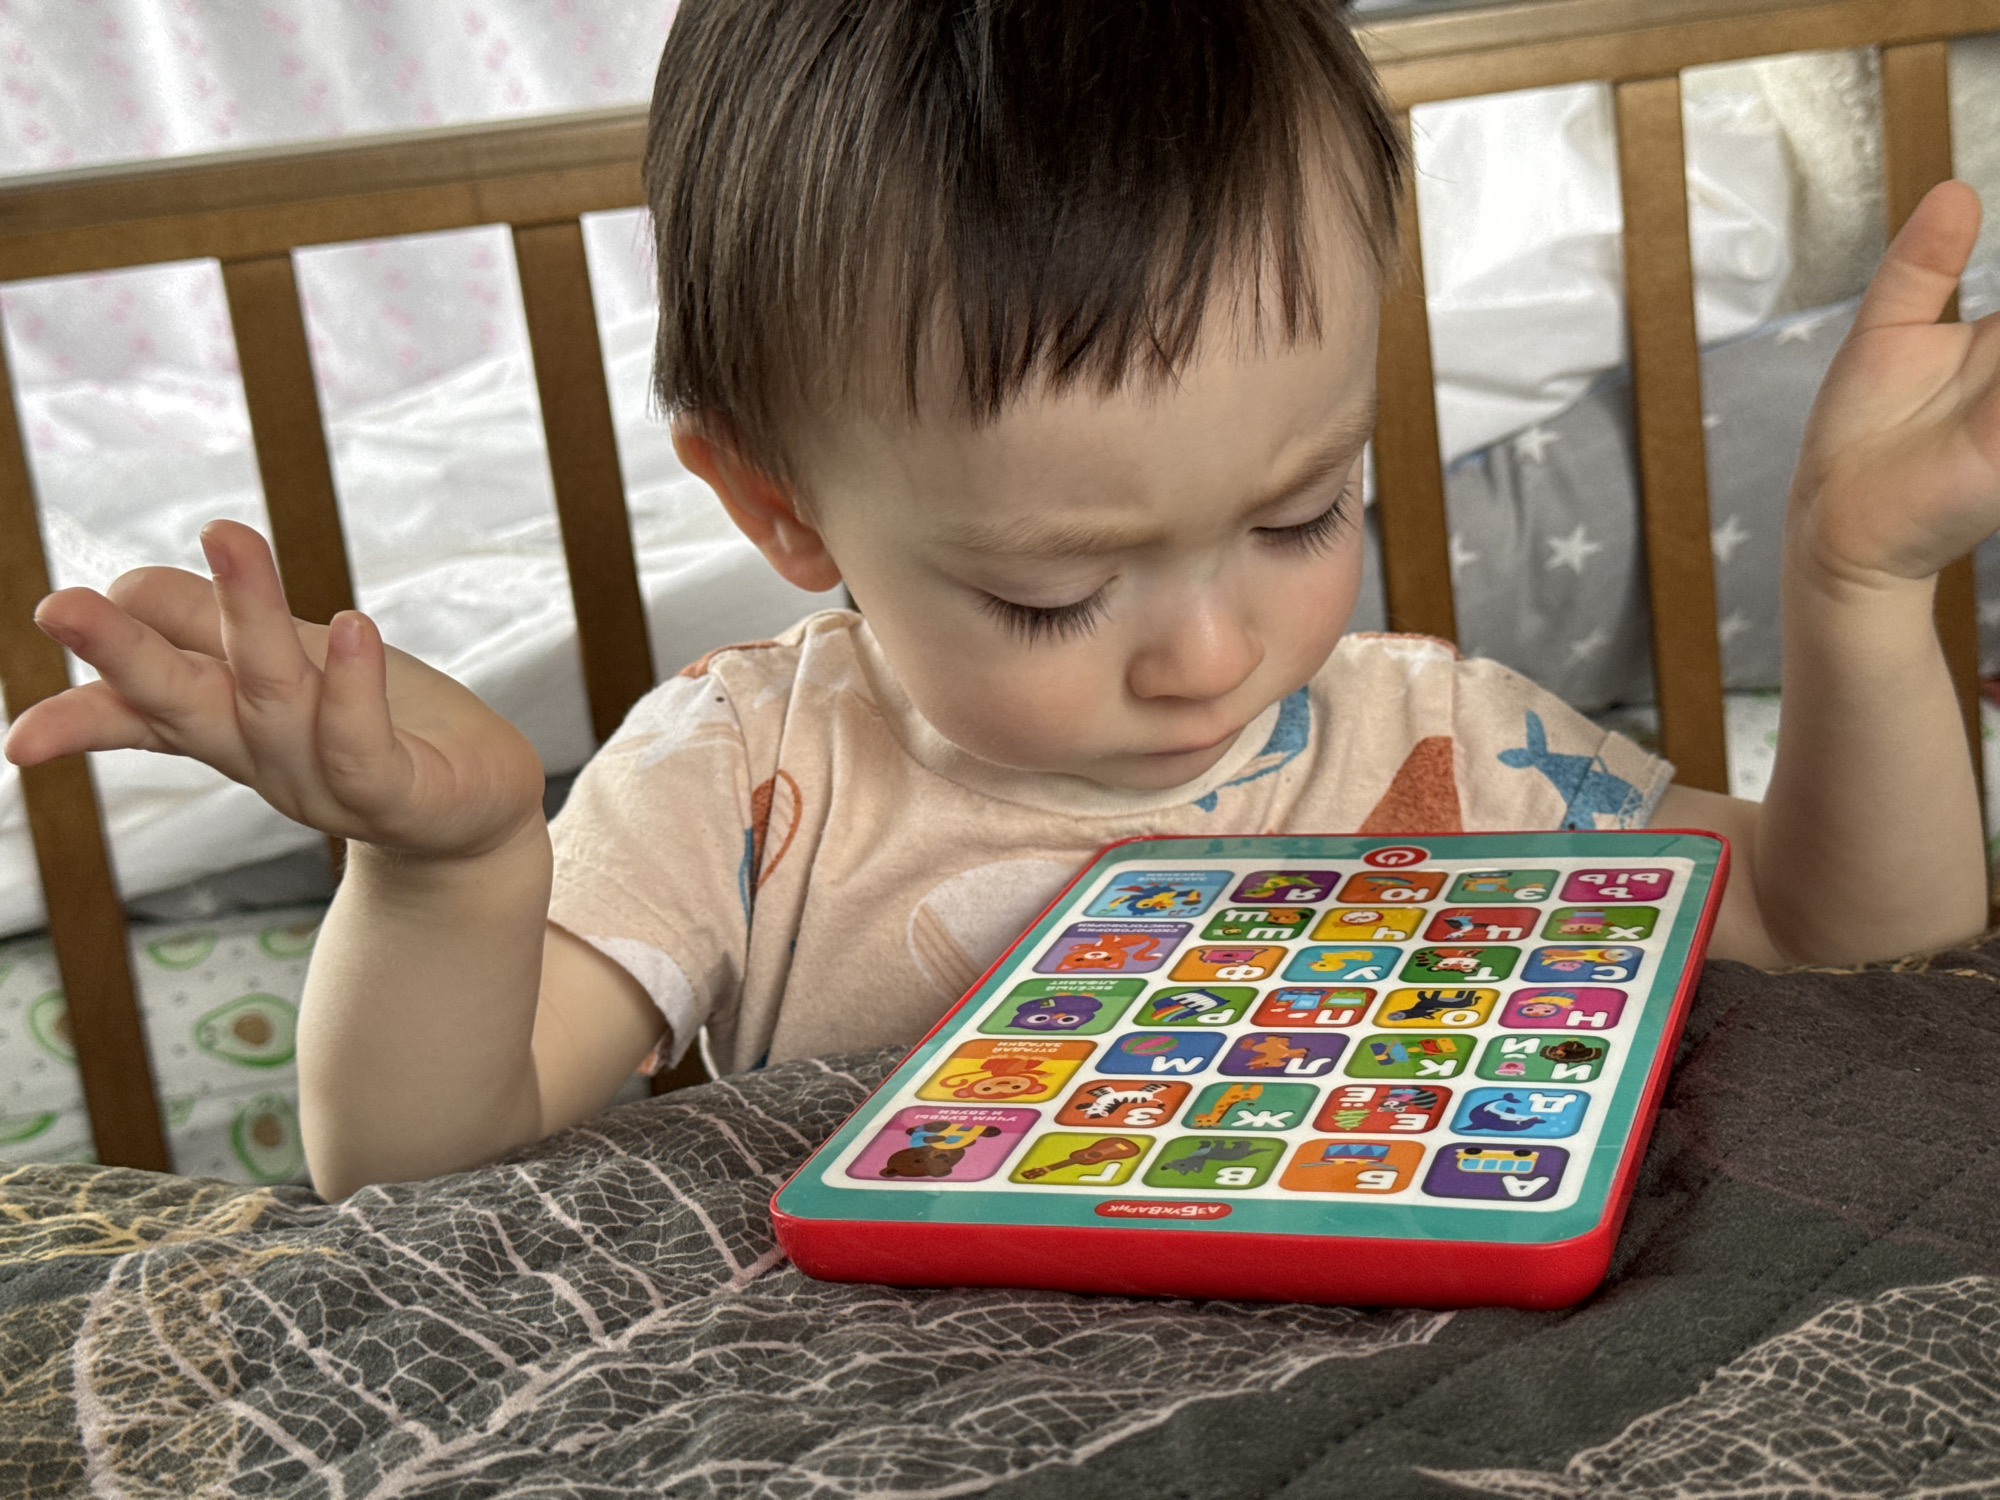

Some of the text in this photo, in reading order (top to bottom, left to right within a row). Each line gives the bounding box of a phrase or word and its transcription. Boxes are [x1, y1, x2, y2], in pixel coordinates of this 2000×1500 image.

[1578, 874, 1607, 884] Ь
[1284, 888, 1322, 900] Я
[1380, 888, 1430, 900] Ю
[1514, 888, 1546, 900] Э
[1599, 887, 1633, 898] Ъ
[1224, 910, 1269, 922] Щ
[1246, 927, 1294, 939] Ш
[1372, 926, 1406, 939] Ч
[1486, 925, 1522, 939] Ц
[1606, 926, 1644, 939] Х
[1216, 965, 1264, 980] Ф
[1343, 966, 1382, 980] У
[1464, 966, 1499, 981] Т
[1591, 966, 1627, 980] С
[1197, 1009, 1235, 1024] Р
[1315, 1009, 1355, 1024] П
[1440, 1010, 1479, 1026] О
[1566, 1011, 1608, 1027] Н
[1500, 1037, 1540, 1059] Й
[1151, 1056, 1204, 1072] М
[1284, 1057, 1332, 1074] Л
[1415, 1059, 1457, 1076] К
[1551, 1063, 1592, 1080] И
[1339, 1087, 1376, 1107] Ё
[1528, 1093, 1577, 1112] Д
[1123, 1107, 1164, 1125] З
[1231, 1110, 1294, 1128] Ж
[1389, 1113, 1429, 1130] Е
[1078, 1162, 1122, 1182] Г
[1215, 1166, 1257, 1186] В
[1355, 1170, 1398, 1190] Б
[1502, 1175, 1550, 1197] А
